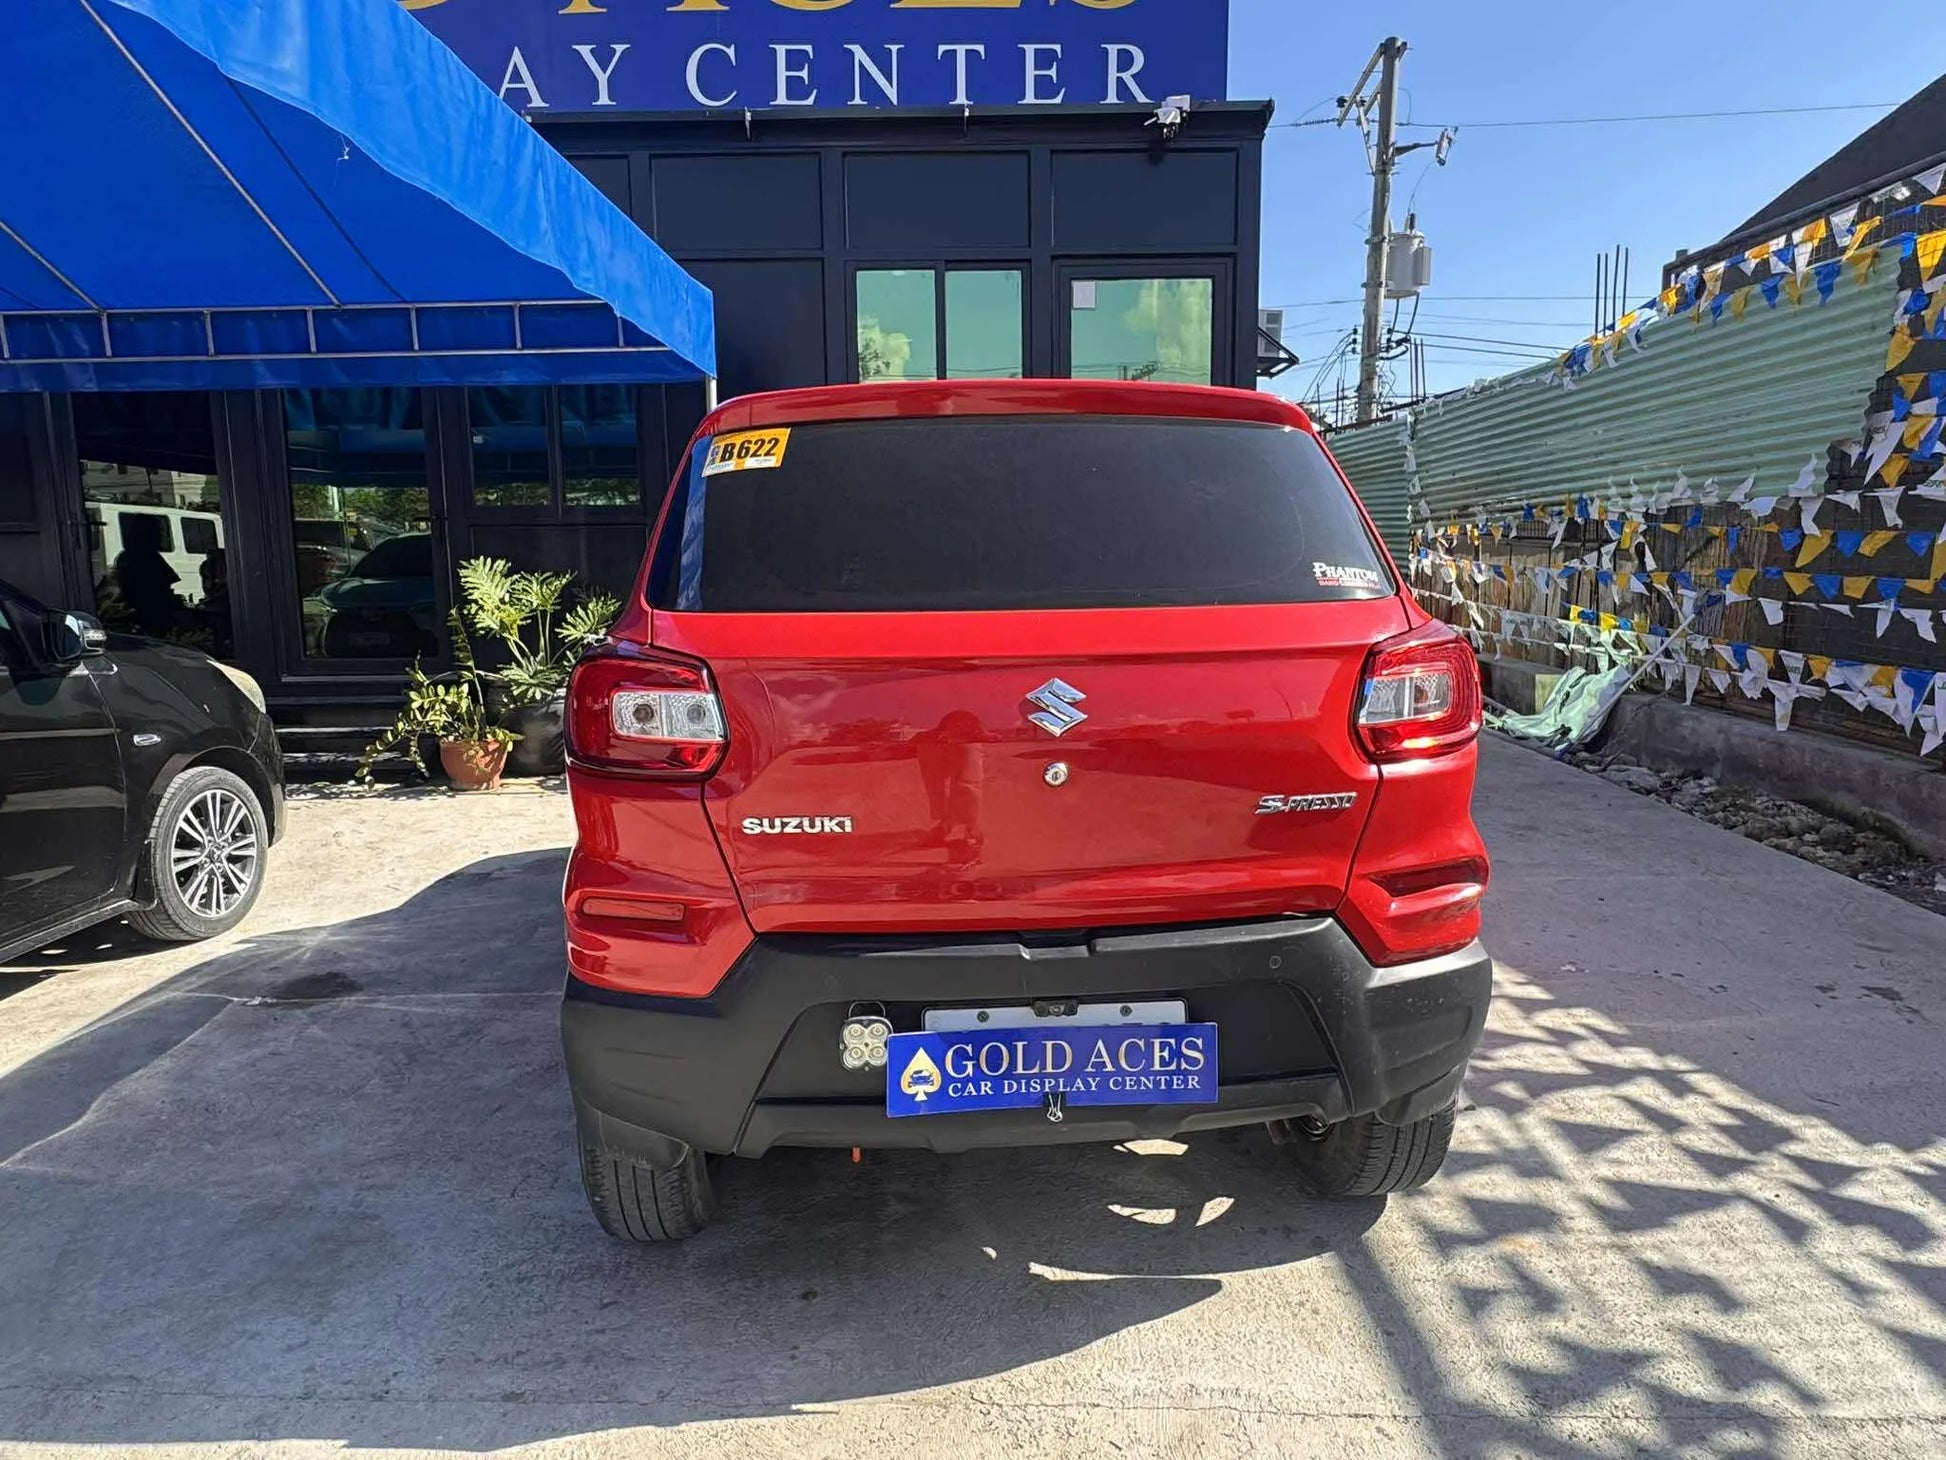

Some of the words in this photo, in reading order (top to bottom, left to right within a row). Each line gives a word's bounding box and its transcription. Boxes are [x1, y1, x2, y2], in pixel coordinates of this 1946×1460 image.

[684, 43, 1156, 106] CENTER
[1312, 562, 1379, 582] PHANTOM
[742, 816, 852, 834] SUZUKI
[944, 1040, 1073, 1079] GOLD
[1086, 1037, 1206, 1072] ACES
[948, 1082, 994, 1098] CAR
[1004, 1077, 1101, 1095] DISPLAY
[1108, 1075, 1201, 1091] CENTER
